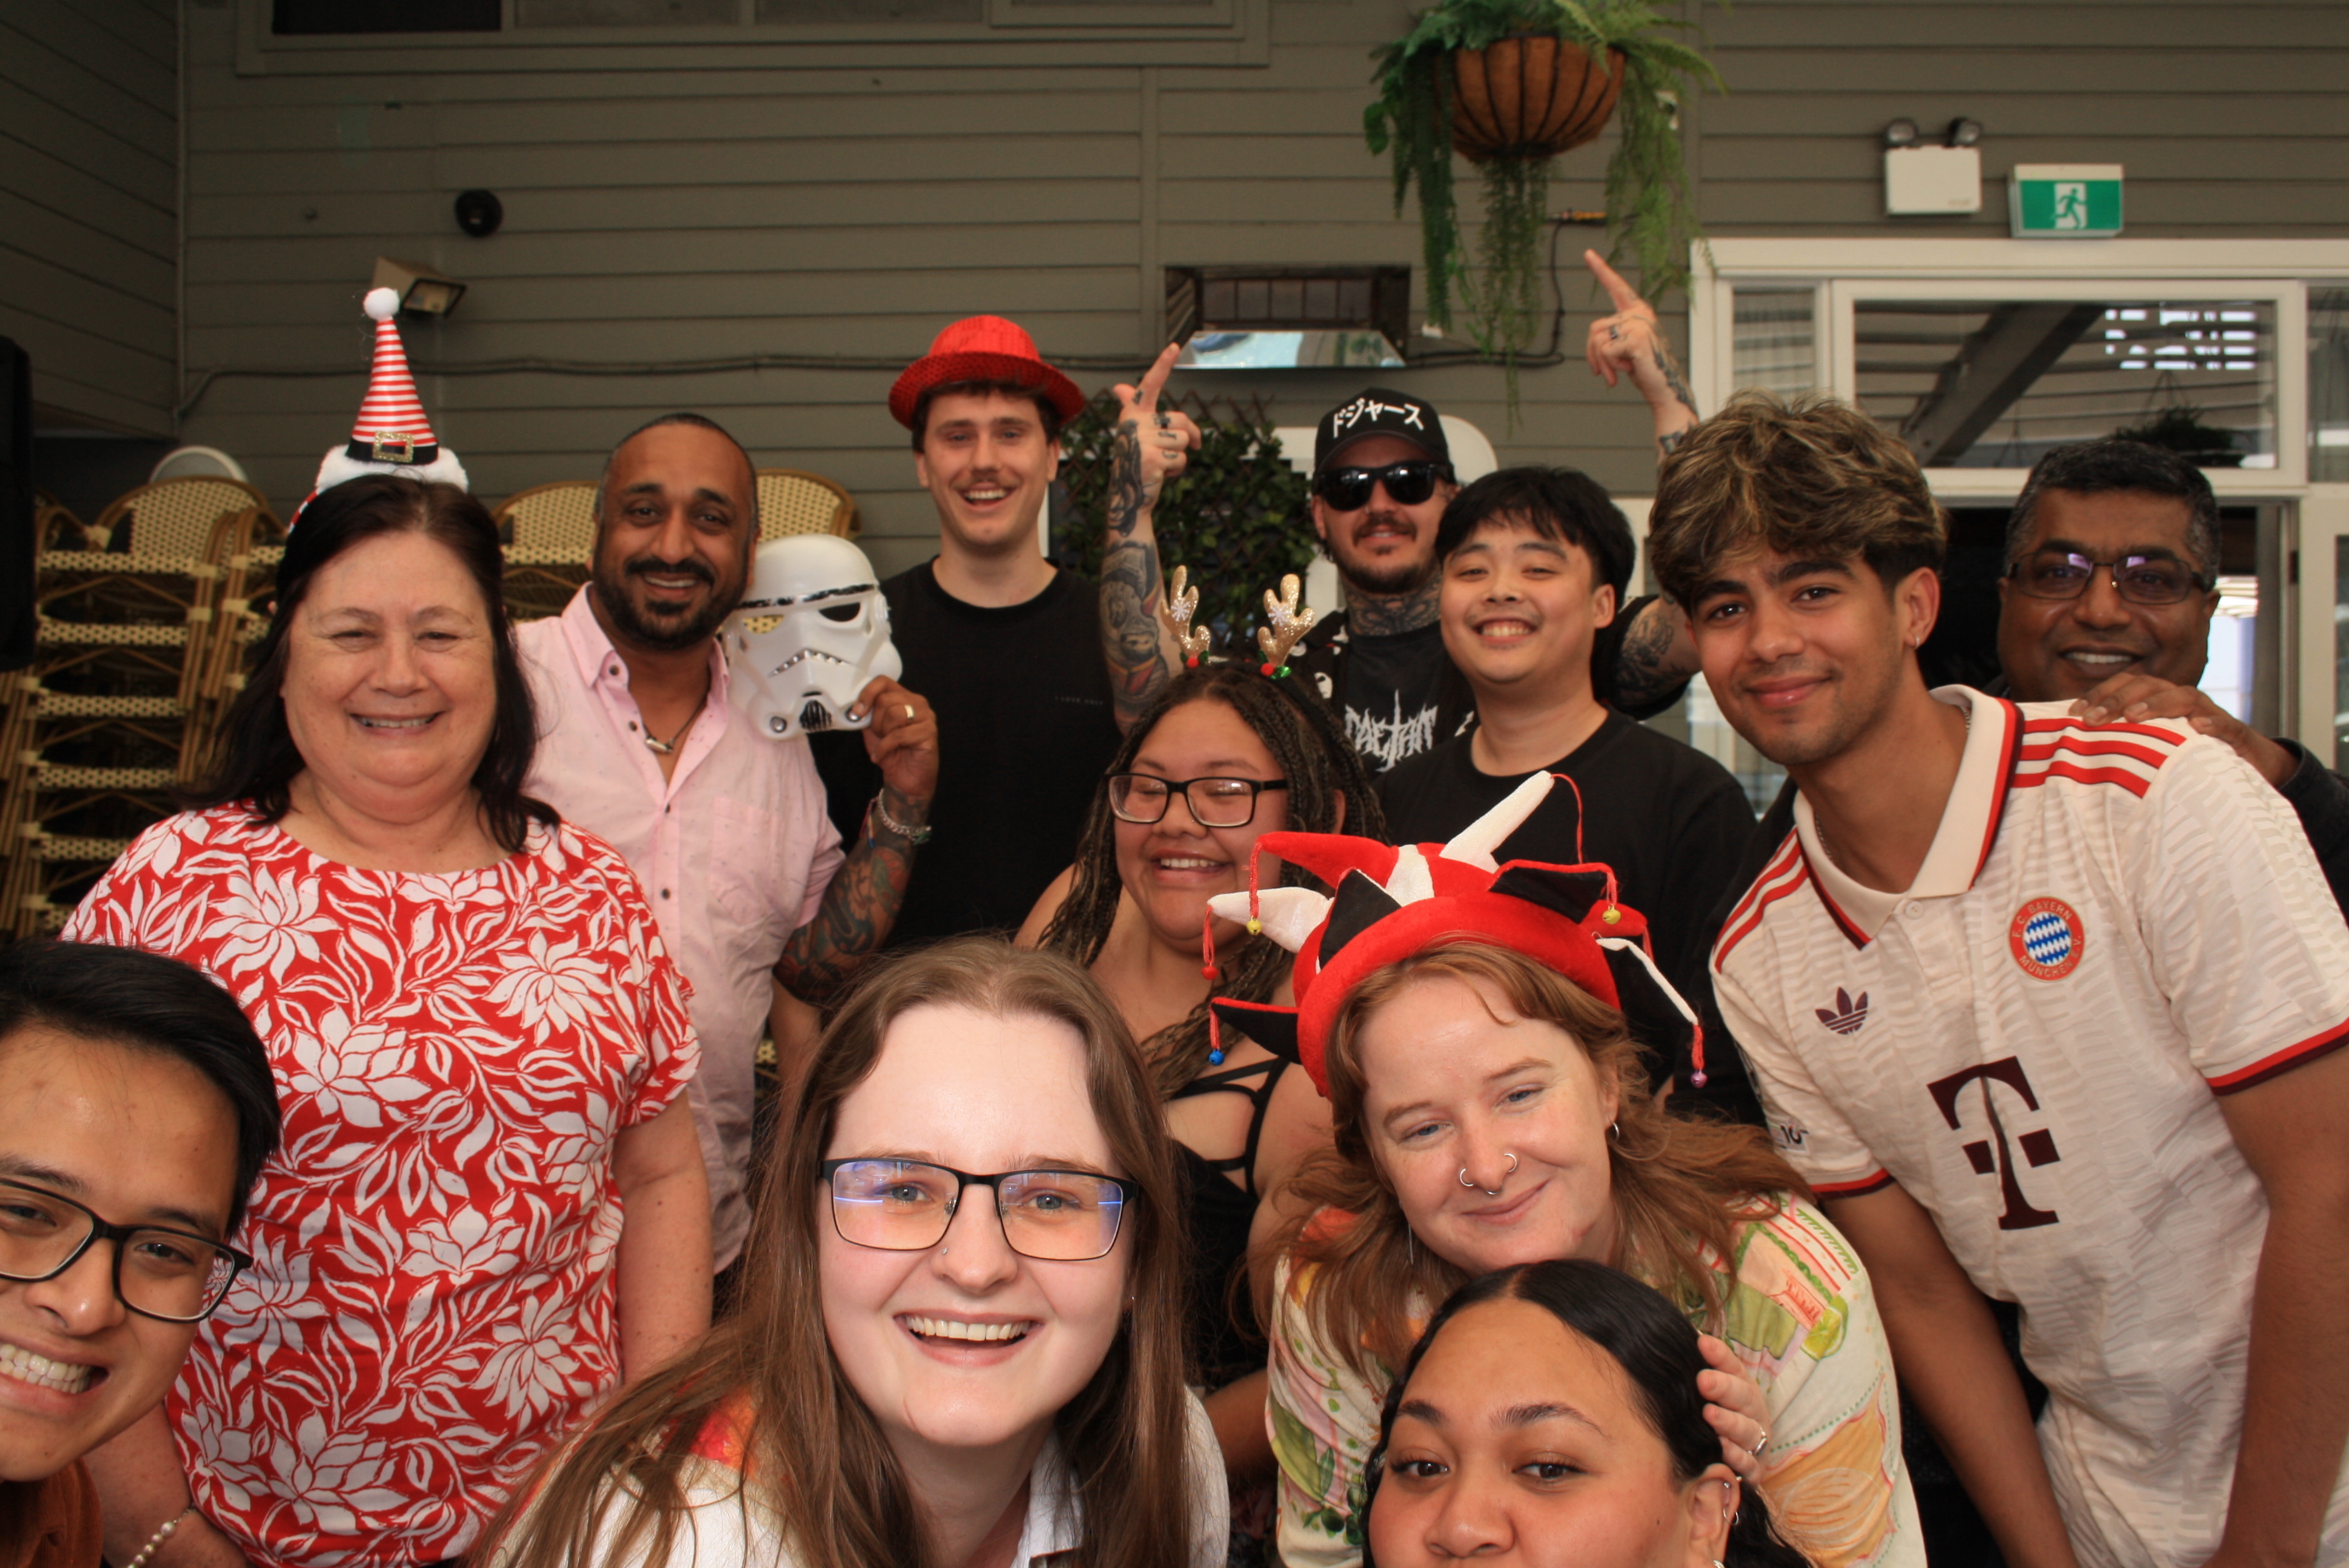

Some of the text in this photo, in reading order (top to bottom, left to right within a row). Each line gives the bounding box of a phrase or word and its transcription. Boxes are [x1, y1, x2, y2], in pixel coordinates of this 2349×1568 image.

[1334, 397, 1425, 439] ドジャース
[2028, 901, 2073, 921] BAYERN
